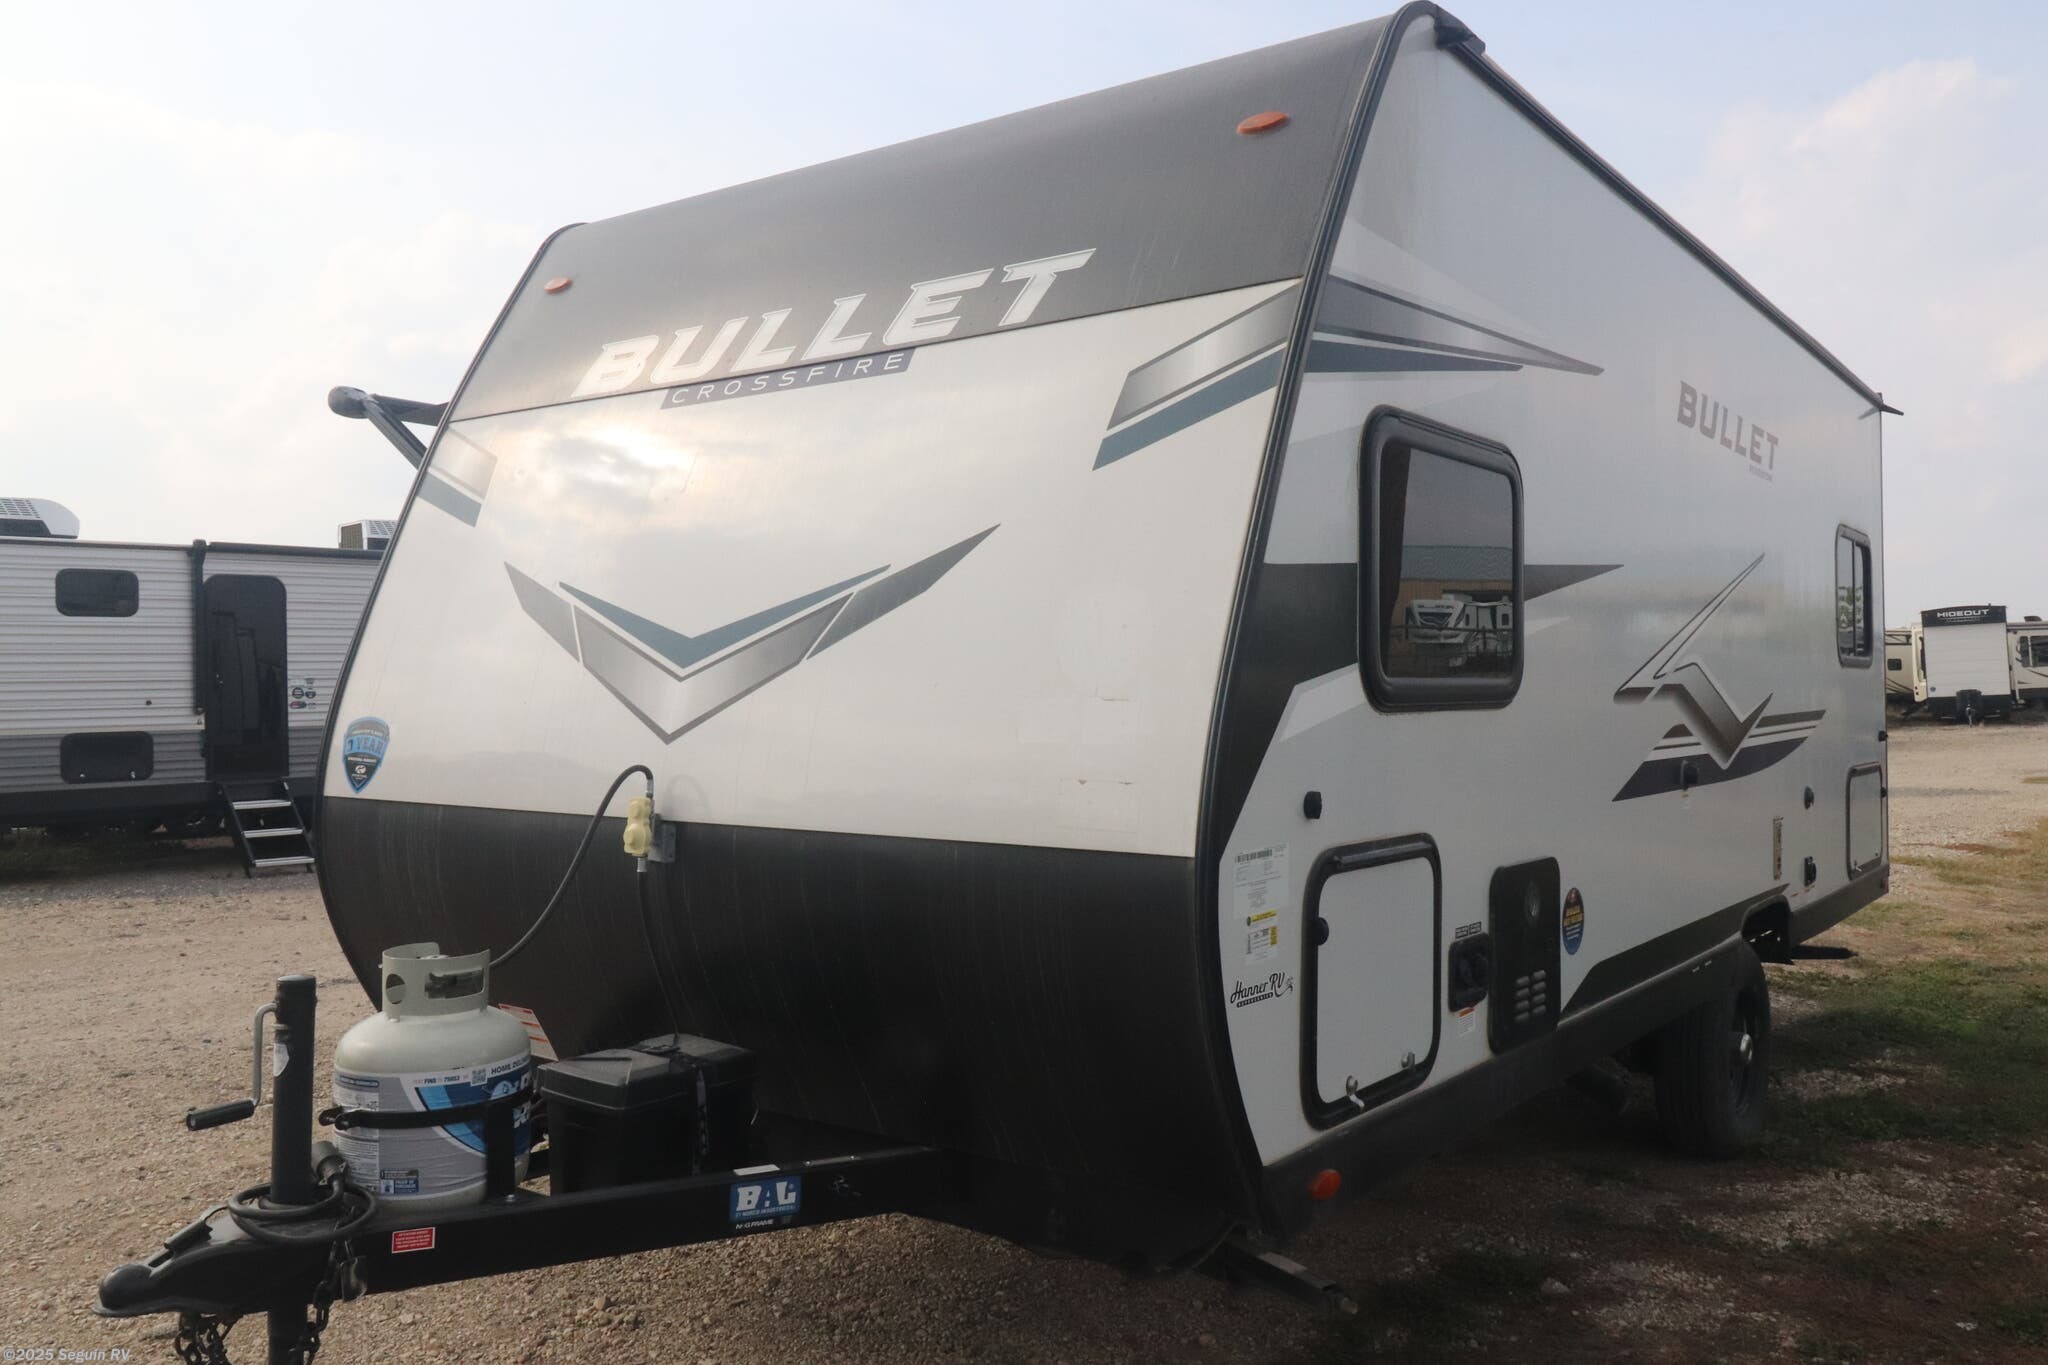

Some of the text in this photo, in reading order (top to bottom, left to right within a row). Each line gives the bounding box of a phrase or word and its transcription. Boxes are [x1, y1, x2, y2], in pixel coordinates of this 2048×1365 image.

[571, 248, 1096, 398] BULLET
[671, 352, 905, 403] CROSSFIRE
[1677, 380, 1779, 470] BULLET
[1936, 608, 1990, 618] HIDEOUT
[1230, 972, 1286, 1004] Hanner RV
[491, 1063, 512, 1075] HOME
